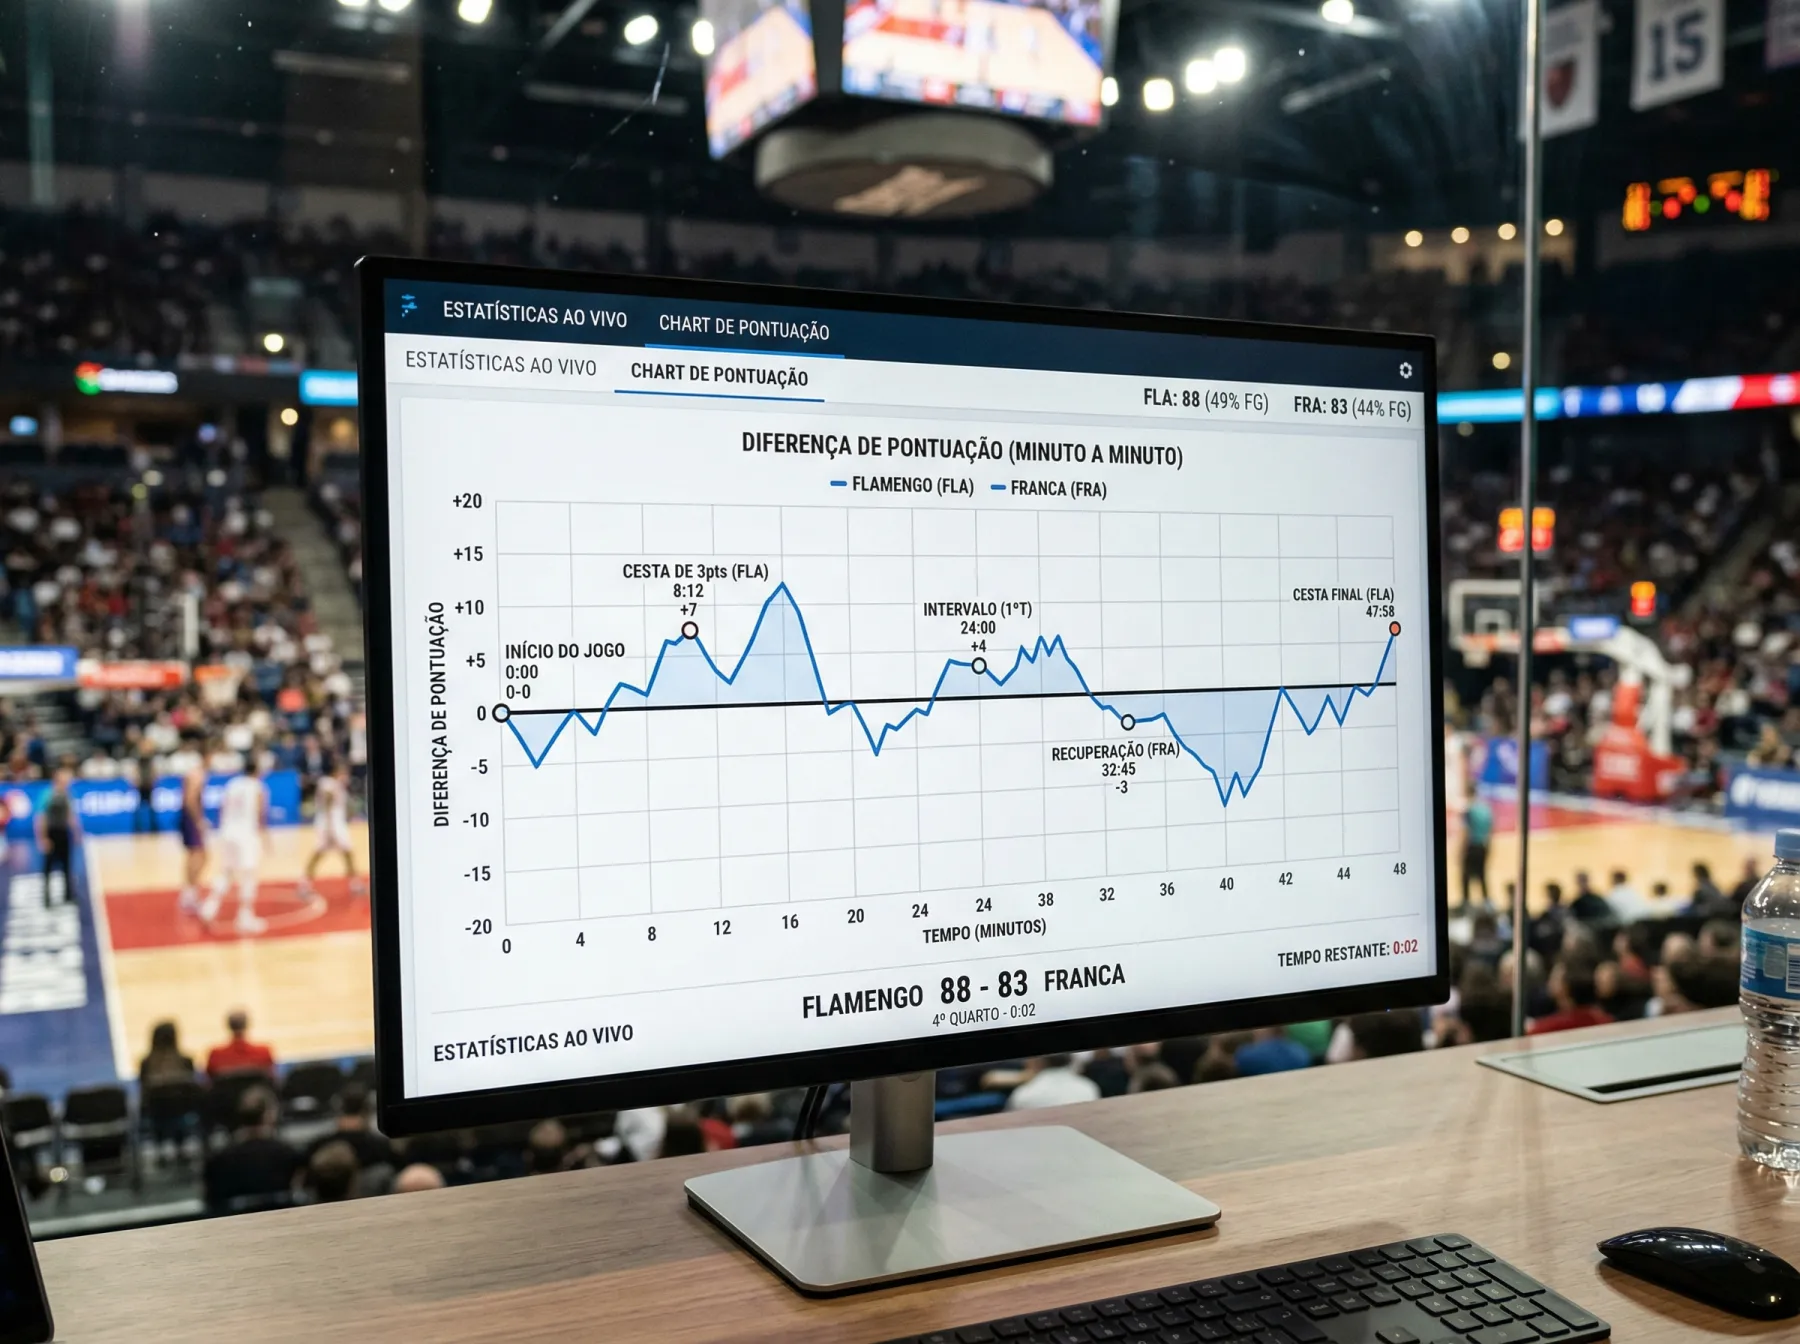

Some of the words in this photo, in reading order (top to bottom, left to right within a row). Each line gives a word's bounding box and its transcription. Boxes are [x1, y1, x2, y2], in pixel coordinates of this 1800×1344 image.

[444, 300, 558, 323] ESTATÍSTICAS
[563, 309, 585, 325] AO
[590, 310, 627, 327] VIVO
[660, 315, 710, 332] CHART
[716, 318, 734, 334] DE
[740, 320, 829, 343] PONTUAÇÃO
[407, 350, 524, 372] ESTATÍSTICAS
[530, 358, 552, 373] AO
[558, 359, 596, 375] VIVO
[632, 363, 685, 380] CHART
[690, 366, 709, 381] DE
[715, 367, 808, 389] PONTUAÇÃO
[1144, 388, 1177, 406] FLA:
[1183, 390, 1200, 407] 88
[1206, 390, 1239, 412] (49%
[1245, 393, 1268, 415] FG)
[1295, 396, 1326, 413] FRA:
[1331, 398, 1347, 414] 83
[1353, 398, 1384, 419] (44%
[1390, 401, 1411, 422] FG)
[743, 432, 852, 460] DIFERENÇA
[858, 436, 881, 455] DE
[888, 436, 1002, 464] PONTUAÇÃO
[1009, 440, 1086, 465] (MINUTO
[1092, 445, 1103, 463] A
[1109, 445, 1182, 470] MINUTO)
[853, 476, 932, 492] FLAMENGO
[938, 478, 973, 497] (FLA)
[1012, 480, 1066, 496] FRANCA
[1071, 481, 1106, 500] (FRA)
[453, 493, 481, 508] +20
[454, 546, 483, 561] +15
[623, 564, 670, 578] CESTA
[675, 564, 693, 578] DE
[698, 564, 727, 582] 3pts
[732, 564, 768, 581] (FLA)
[674, 584, 703, 597] 8:12
[1293, 588, 1328, 601] CESTA
[1332, 588, 1363, 600] FINAL
[1367, 588, 1394, 603] (FLA)
[455, 600, 484, 615] +10
[681, 603, 697, 616] +7
[924, 602, 996, 616] INTERVALO
[1366, 605, 1394, 617] 47:58
[961, 621, 995, 634] 24:00
[425, 603, 448, 705] PONTUAÇÃO
[506, 641, 553, 659] INÍCIO
[559, 644, 579, 658] DO
[584, 643, 624, 657] JOGO
[971, 640, 986, 652] +4
[466, 653, 485, 668] +5
[506, 665, 538, 679] 0:00
[507, 684, 530, 699] 0-0
[431, 711, 446, 730] DE
[477, 706, 486, 721] 0
[1053, 741, 1143, 761] RECUPERAÇÃO
[1148, 741, 1180, 759] (FRA)
[471, 759, 487, 774] -5
[1102, 762, 1135, 776] 32:45
[432, 736, 452, 826] DIFERENÇA
[1116, 780, 1128, 793] -3
[463, 812, 489, 827] -10
[464, 866, 490, 881] -15
[502, 939, 511, 953] 0
[576, 932, 585, 946] 4
[714, 920, 731, 935] 12
[782, 914, 798, 929] 16
[848, 909, 864, 923] 20
[912, 903, 928, 918] 24
[976, 898, 992, 912] 24
[1038, 893, 1053, 906] 38
[1100, 887, 1114, 901] 32
[1160, 882, 1174, 896] 36
[1220, 877, 1233, 890] 40
[1279, 872, 1293, 885] 42
[1337, 867, 1350, 880] 44
[1394, 862, 1406, 874] 48
[465, 919, 491, 935] -20
[923, 926, 970, 943] TEMPO
[975, 918, 1046, 942] (MINUTOS)
[1278, 950, 1321, 967] TEMPO
[1325, 943, 1389, 962] RESTANTE:
[1394, 939, 1418, 954] 0:02
[803, 985, 923, 1018] FLAMENGO
[941, 976, 970, 1004] 88
[999, 970, 1027, 998] 83
[1045, 964, 1125, 991] FRANCA
[950, 1006, 1000, 1026] QUARTO
[1011, 1003, 1035, 1018] 0:02
[435, 1033, 558, 1061] ESTATÍSTICAS
[564, 1030, 587, 1047] AO
[593, 1025, 633, 1044] VIVO
